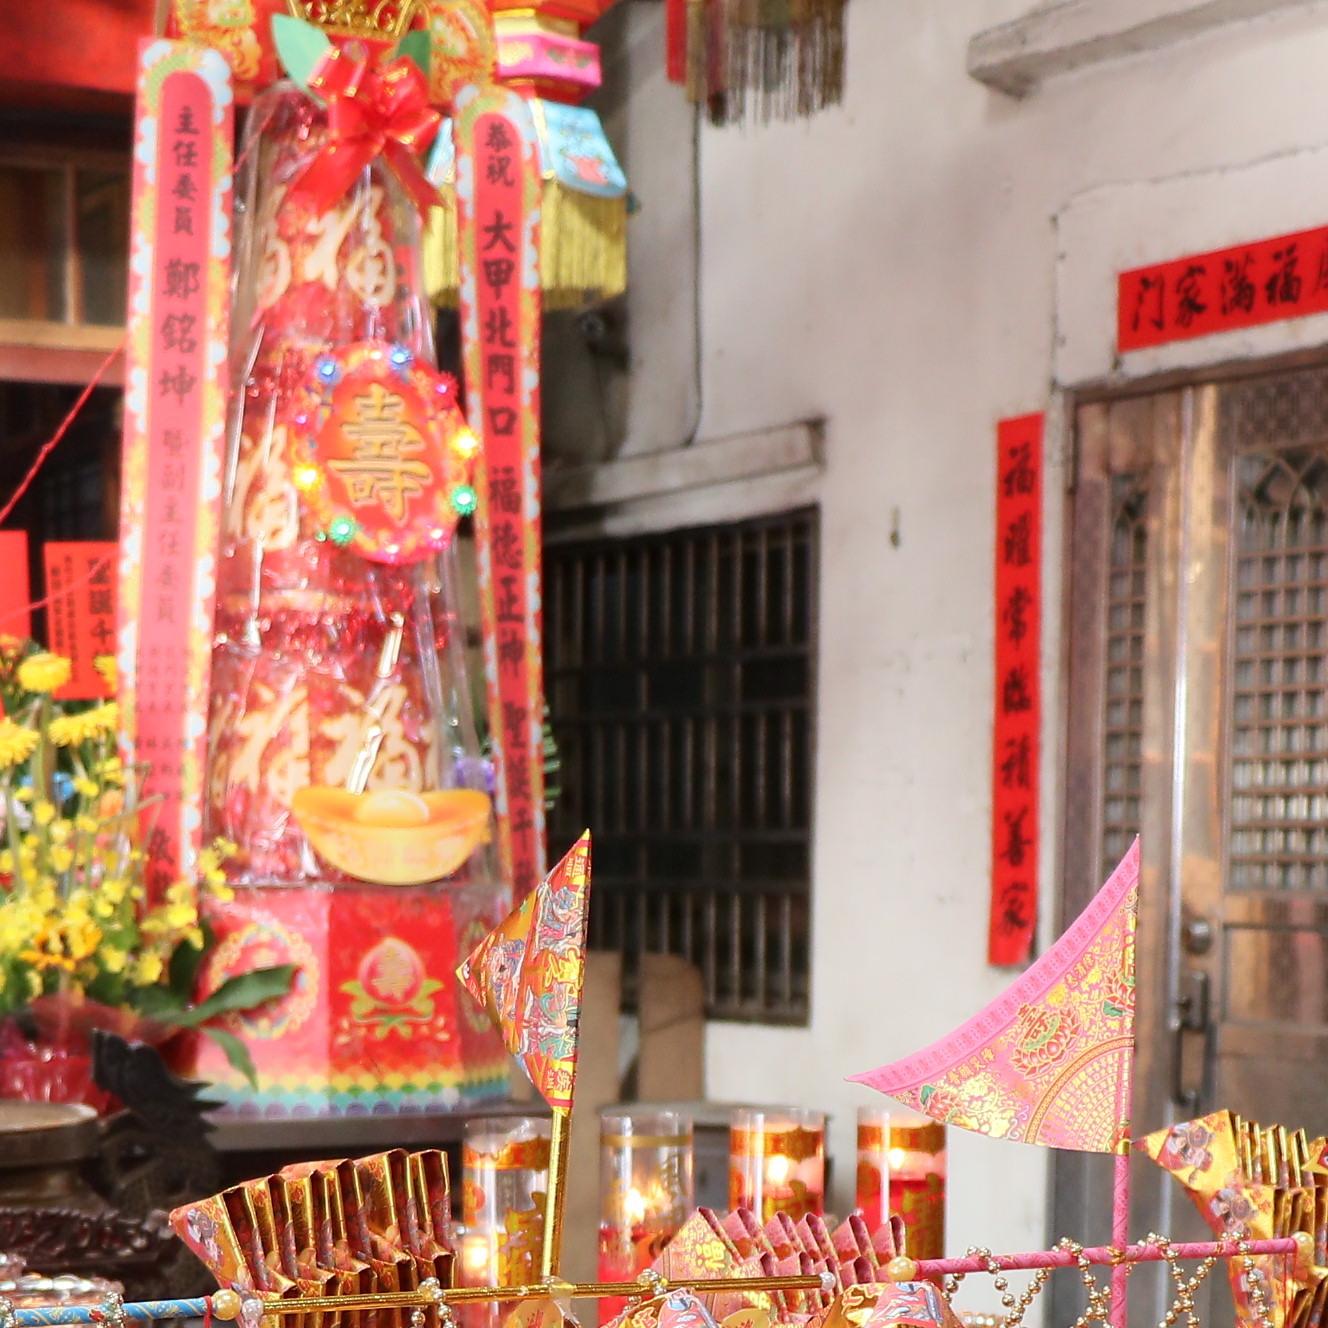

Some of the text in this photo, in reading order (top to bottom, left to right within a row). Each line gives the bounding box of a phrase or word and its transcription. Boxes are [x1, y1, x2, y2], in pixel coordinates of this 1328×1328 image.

[172, 106, 200, 236] 主任委員
[484, 122, 515, 188] 恭祝
[481, 211, 517, 437] 大甲北門口
[327, 382, 435, 525] 壽
[489, 466, 525, 676] 福德正神
